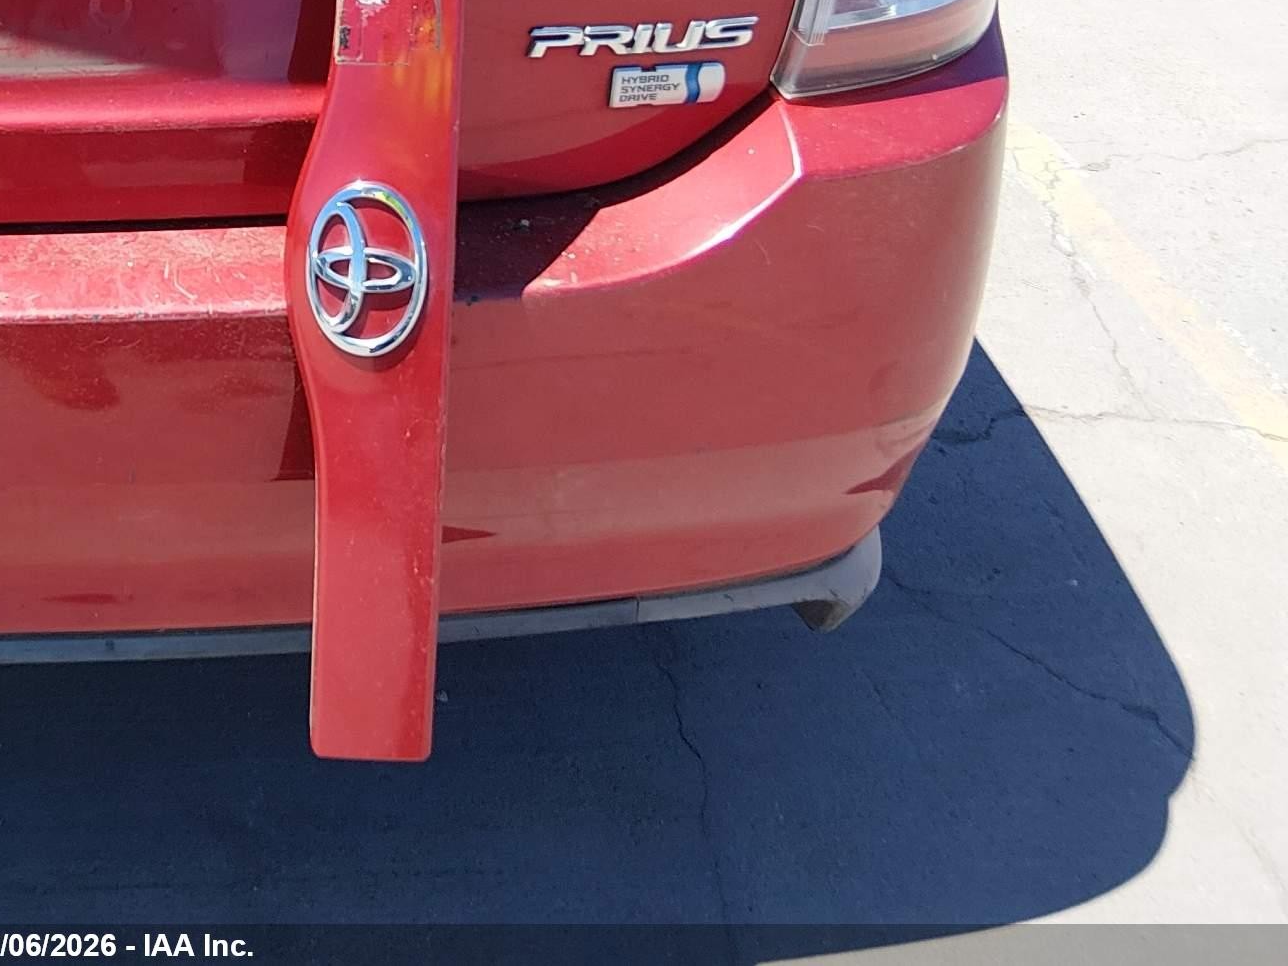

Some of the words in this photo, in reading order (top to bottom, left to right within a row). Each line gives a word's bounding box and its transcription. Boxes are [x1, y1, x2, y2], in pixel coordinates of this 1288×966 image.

[527, 15, 759, 59] PRIUS
[621, 74, 670, 85] HYBRID
[620, 83, 681, 94] SYNERGY
[619, 93, 657, 103] DRIVE
